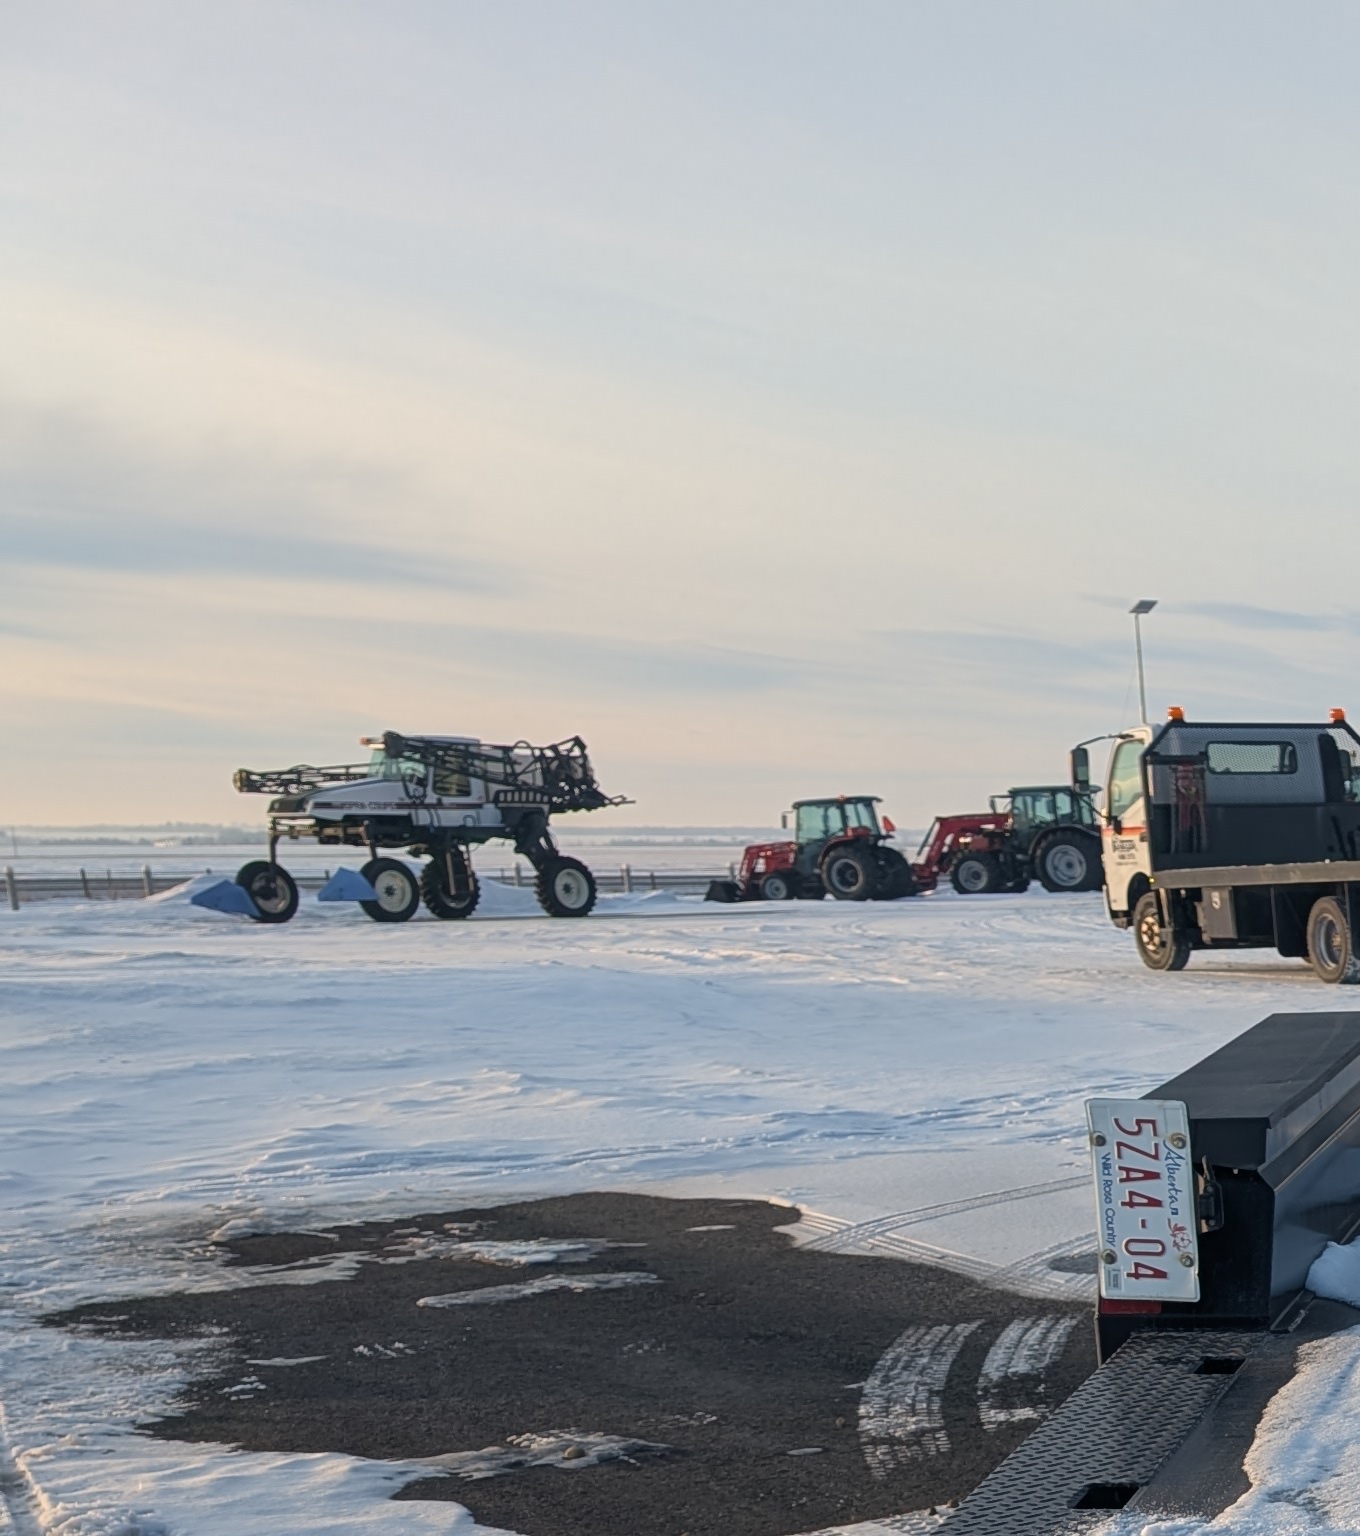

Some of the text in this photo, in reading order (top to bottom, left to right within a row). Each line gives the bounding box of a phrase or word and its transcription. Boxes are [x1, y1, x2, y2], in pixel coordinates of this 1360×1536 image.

[1101, 1152, 1117, 1247] Wild Rose Country
[1113, 1117, 1169, 1280] 5ZA4-04
[1163, 1139, 1185, 1211] Alberta
